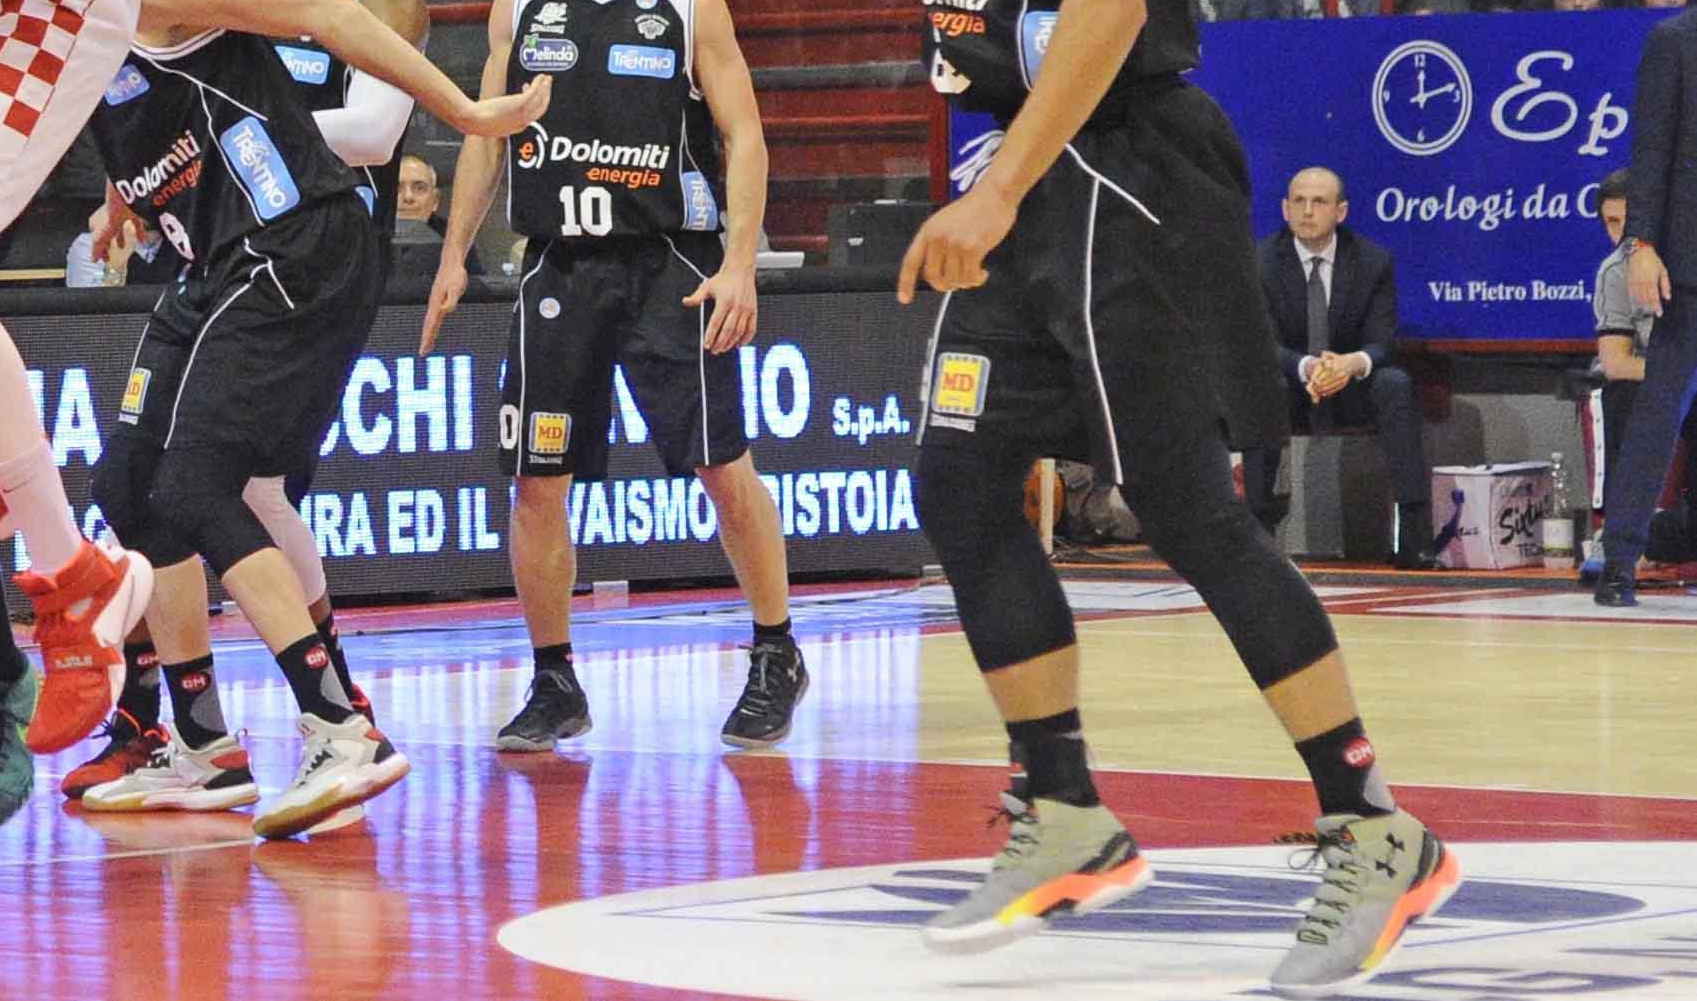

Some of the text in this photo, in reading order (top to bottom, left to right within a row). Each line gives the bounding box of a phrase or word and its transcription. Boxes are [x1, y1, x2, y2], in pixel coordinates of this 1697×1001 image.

[550, 136, 671, 170] Dolomiti
[586, 167, 662, 189] energia
[558, 185, 613, 237] 10
[1376, 184, 1516, 231] Orologi
[1523, 182, 1568, 219] da
[1428, 279, 1593, 303] Via Pietro Bozzi,
[942, 371, 975, 392] MD
[537, 421, 564, 440] MD
[833, 395, 911, 445] S.p.A.
[387, 489, 446, 554] ED
[458, 487, 500, 550] IL
